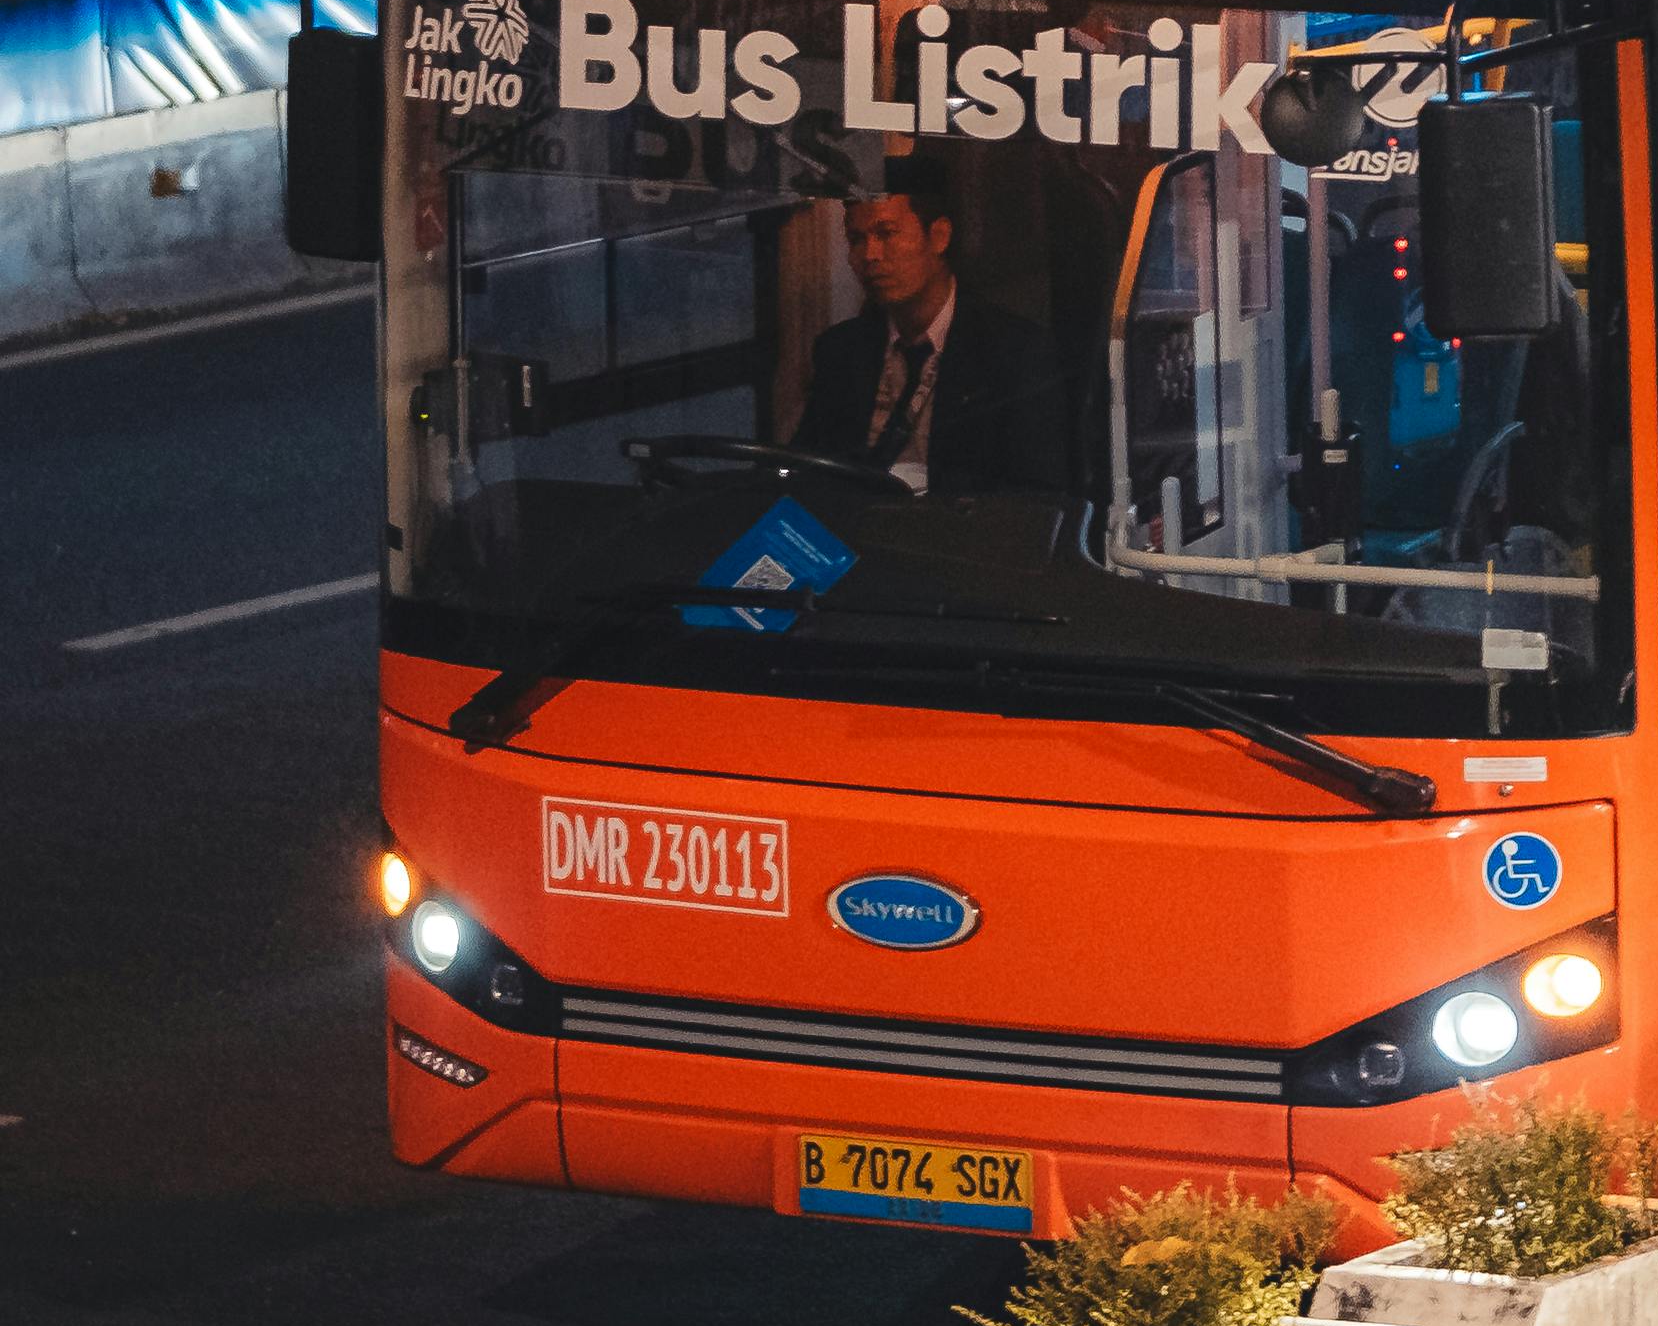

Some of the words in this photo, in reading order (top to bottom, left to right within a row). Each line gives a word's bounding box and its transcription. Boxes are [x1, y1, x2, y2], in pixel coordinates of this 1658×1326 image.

[405, 5, 465, 53] Jak
[403, 54, 522, 115] Lingko
[844, 4, 1279, 155] Listrik
[549, 812, 631, 887] DMR
[642, 821, 780, 902] 230113
[845, 896, 954, 924] Skywell
[805, 1141, 826, 1185] B
[847, 1144, 934, 1194] 7074
[957, 1154, 1023, 1201] SGX
